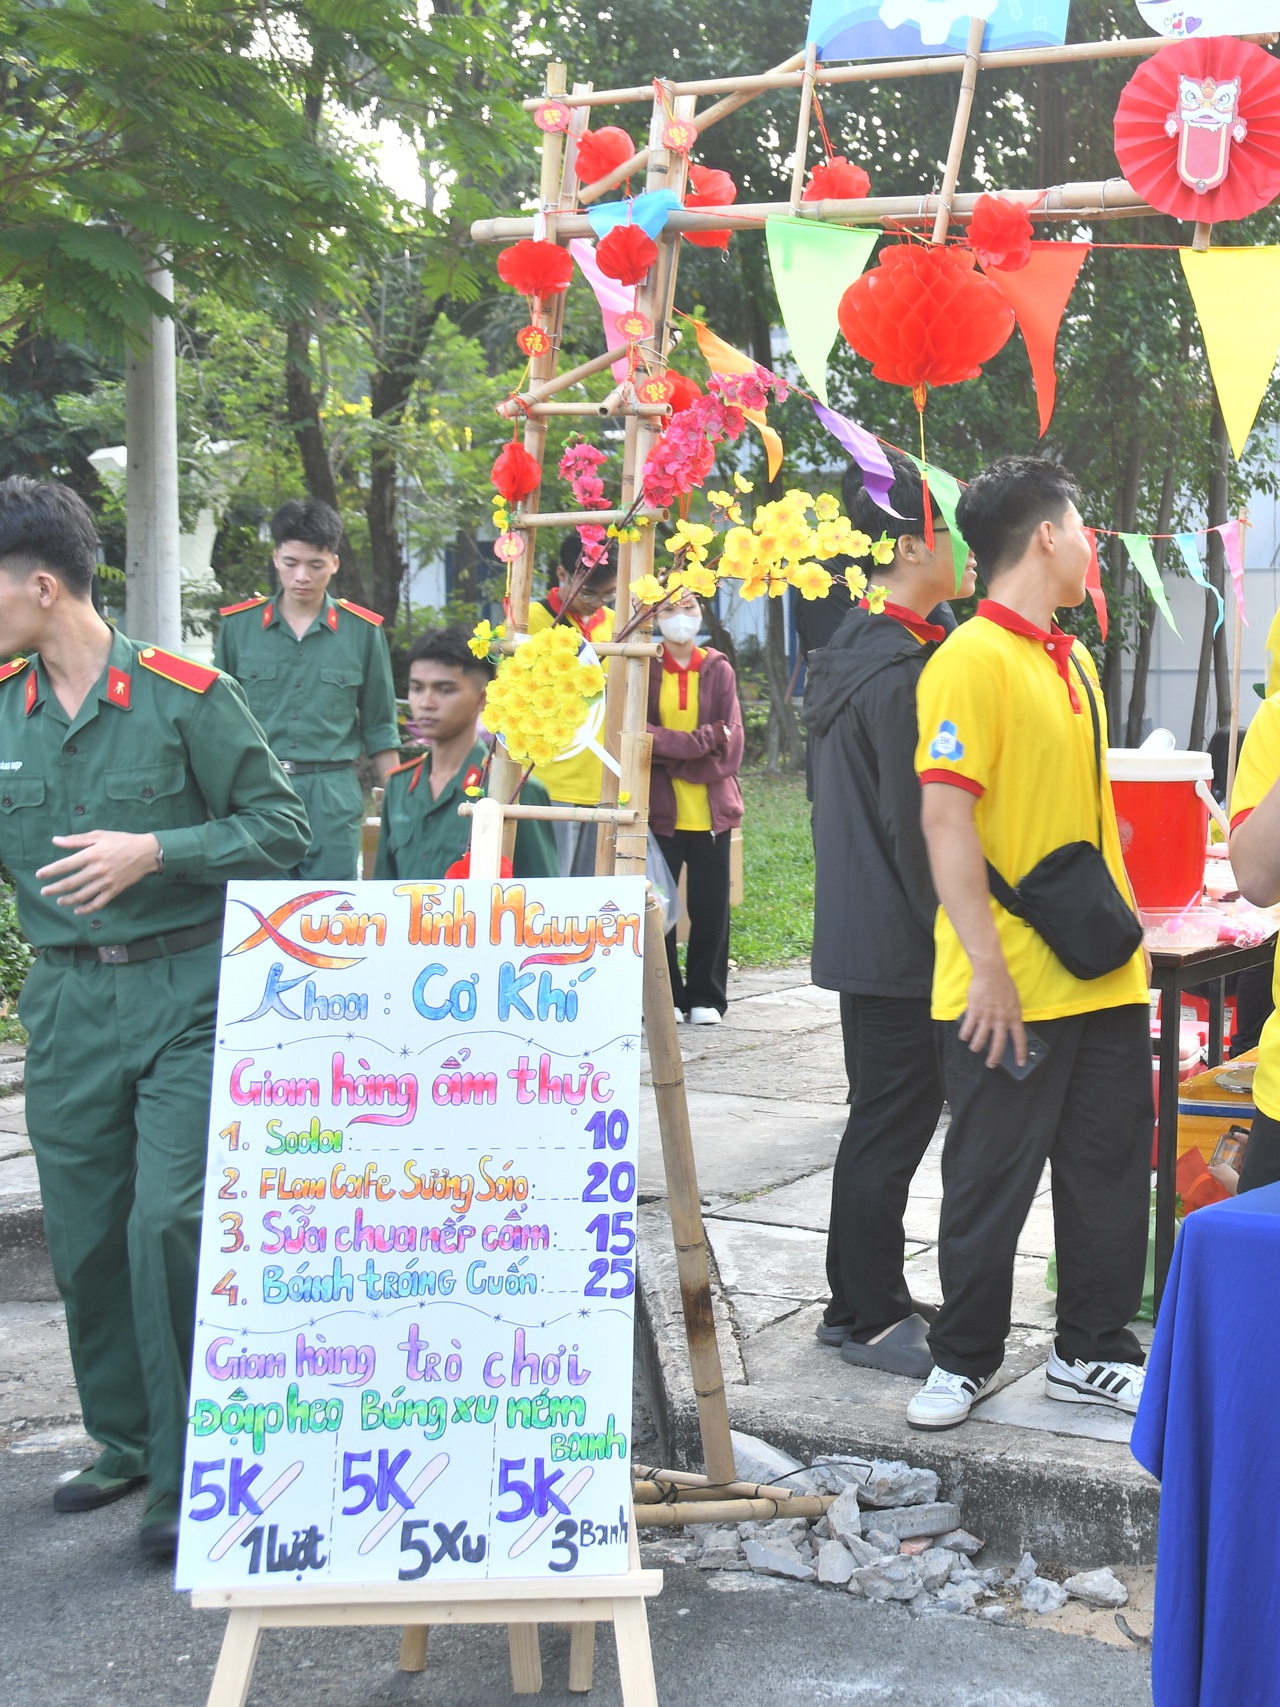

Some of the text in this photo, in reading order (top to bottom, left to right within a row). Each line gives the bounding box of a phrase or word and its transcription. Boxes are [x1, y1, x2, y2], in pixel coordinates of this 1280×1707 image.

[525, 332, 543, 353] 福
[223, 889, 387, 970] Xuân
[393, 883, 477, 948] Tình
[413, 963, 480, 1022] Cơ
[498, 961, 597, 1023] Khí
[229, 1047, 615, 1128] Gian hàng ẩm thực
[218, 1120, 251, 1152] 1.
[584, 1108, 630, 1150] 10
[217, 1167, 248, 1200] 2.
[330, 1161, 397, 1202] Cafe
[582, 1161, 636, 1203] 20
[218, 1211, 251, 1254] 3.
[260, 1204, 328, 1254] Sữa
[585, 1211, 636, 1256] 15
[210, 1268, 248, 1307] 4.
[262, 1255, 354, 1304] Bánh
[583, 1257, 635, 1299] 25
[205, 1335, 286, 1381] Gian
[295, 1332, 376, 1388] hàng
[483, 1327, 592, 1388] chơi
[188, 1382, 345, 1456] Đập heo
[361, 1385, 499, 1441] Búng xu
[506, 1387, 587, 1430] ném
[550, 1413, 627, 1463] Banh
